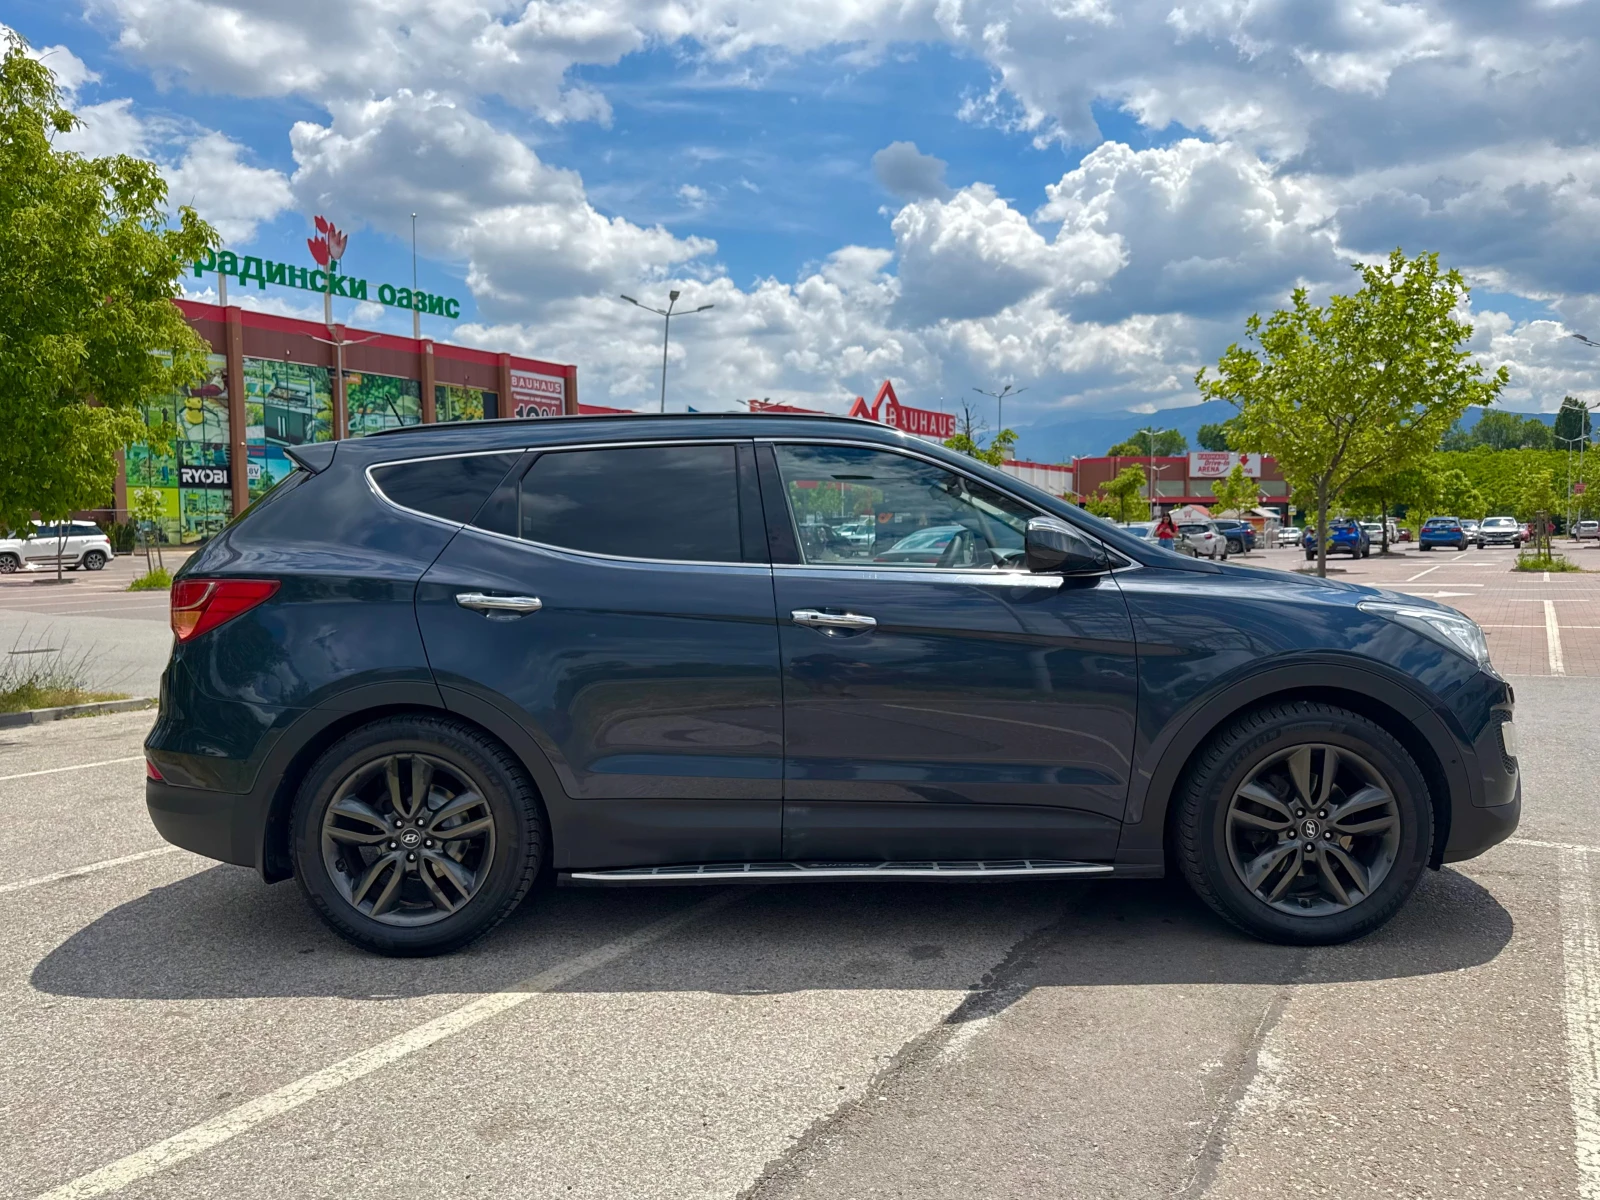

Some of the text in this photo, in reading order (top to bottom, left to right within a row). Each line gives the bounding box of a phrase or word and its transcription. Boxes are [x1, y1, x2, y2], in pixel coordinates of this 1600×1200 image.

[192, 248, 460, 319] радински оазис
[511, 376, 560, 393] BAUHAUS
[889, 407, 955, 436] BAUHAUS
[181, 468, 228, 484] RYOBI
